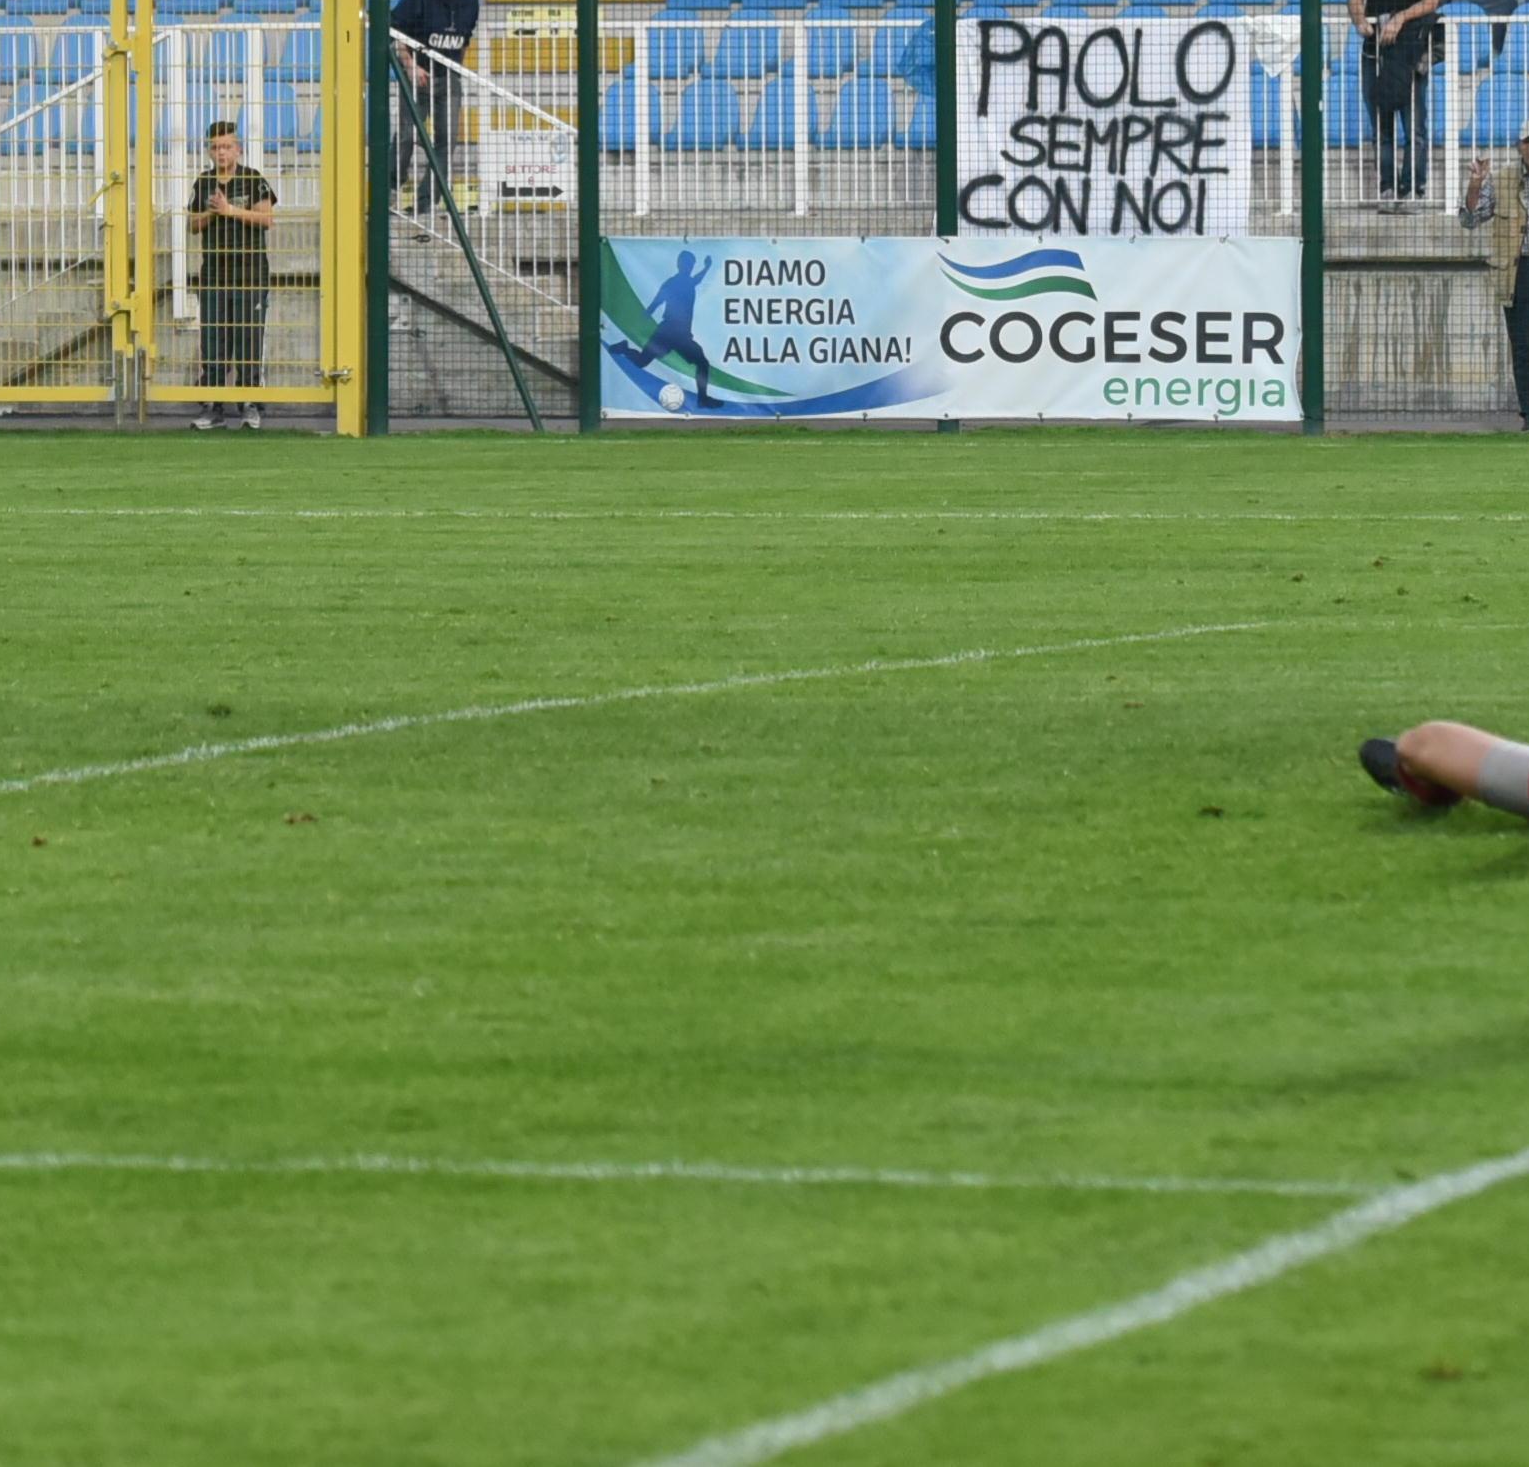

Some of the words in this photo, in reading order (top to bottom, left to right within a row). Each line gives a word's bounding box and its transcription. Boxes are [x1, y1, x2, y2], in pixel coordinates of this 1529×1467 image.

[977, 20, 1235, 117] PAOLO
[1000, 112, 1230, 177] SEMPRE
[959, 174, 1092, 235] CON
[1110, 177, 1206, 235] NOI
[724, 259, 826, 286] DIAMO
[724, 298, 856, 325] ENERGIA
[723, 337, 800, 363] ALLA
[809, 336, 912, 364] GIANA!
[939, 311, 1285, 365] COGESER
[1102, 377, 1286, 416] energia
